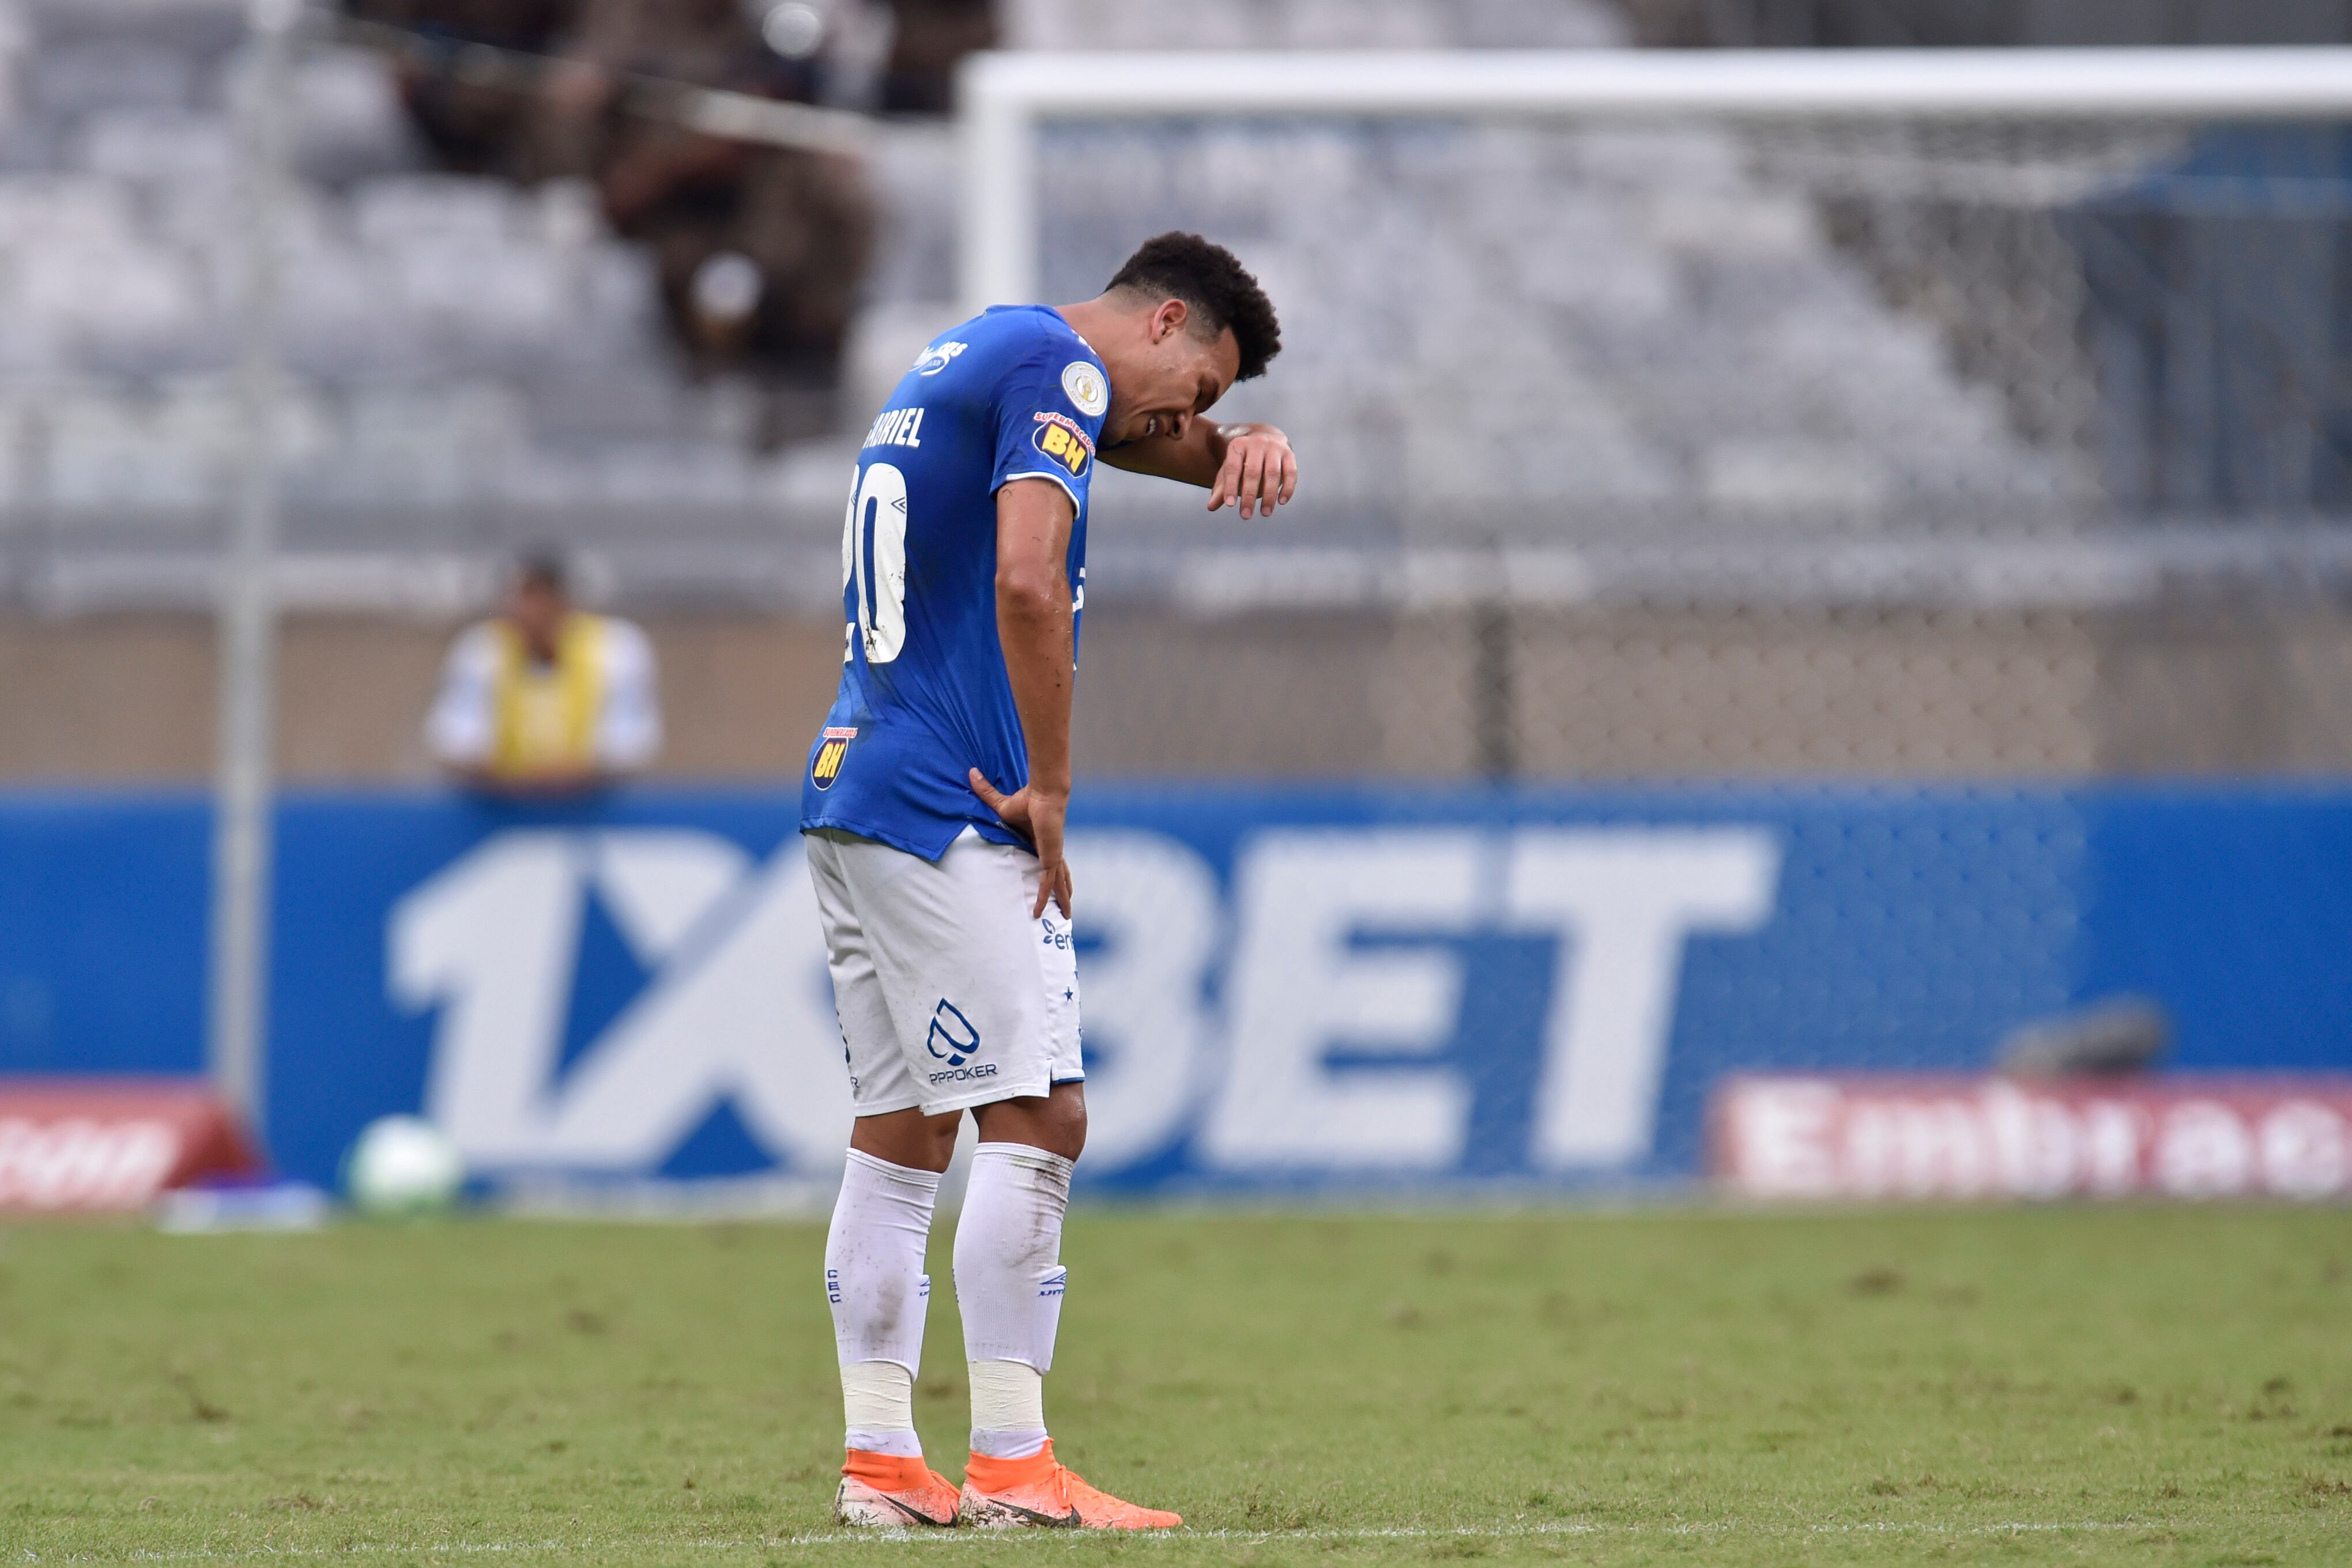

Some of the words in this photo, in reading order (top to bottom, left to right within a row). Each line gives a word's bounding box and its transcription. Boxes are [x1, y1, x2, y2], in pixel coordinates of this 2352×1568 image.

[1042, 423, 1086, 473] BH
[814, 741, 846, 778] BH
[385, 826, 1780, 1170] 1XBET
[929, 1064, 998, 1085] PPPOKER
